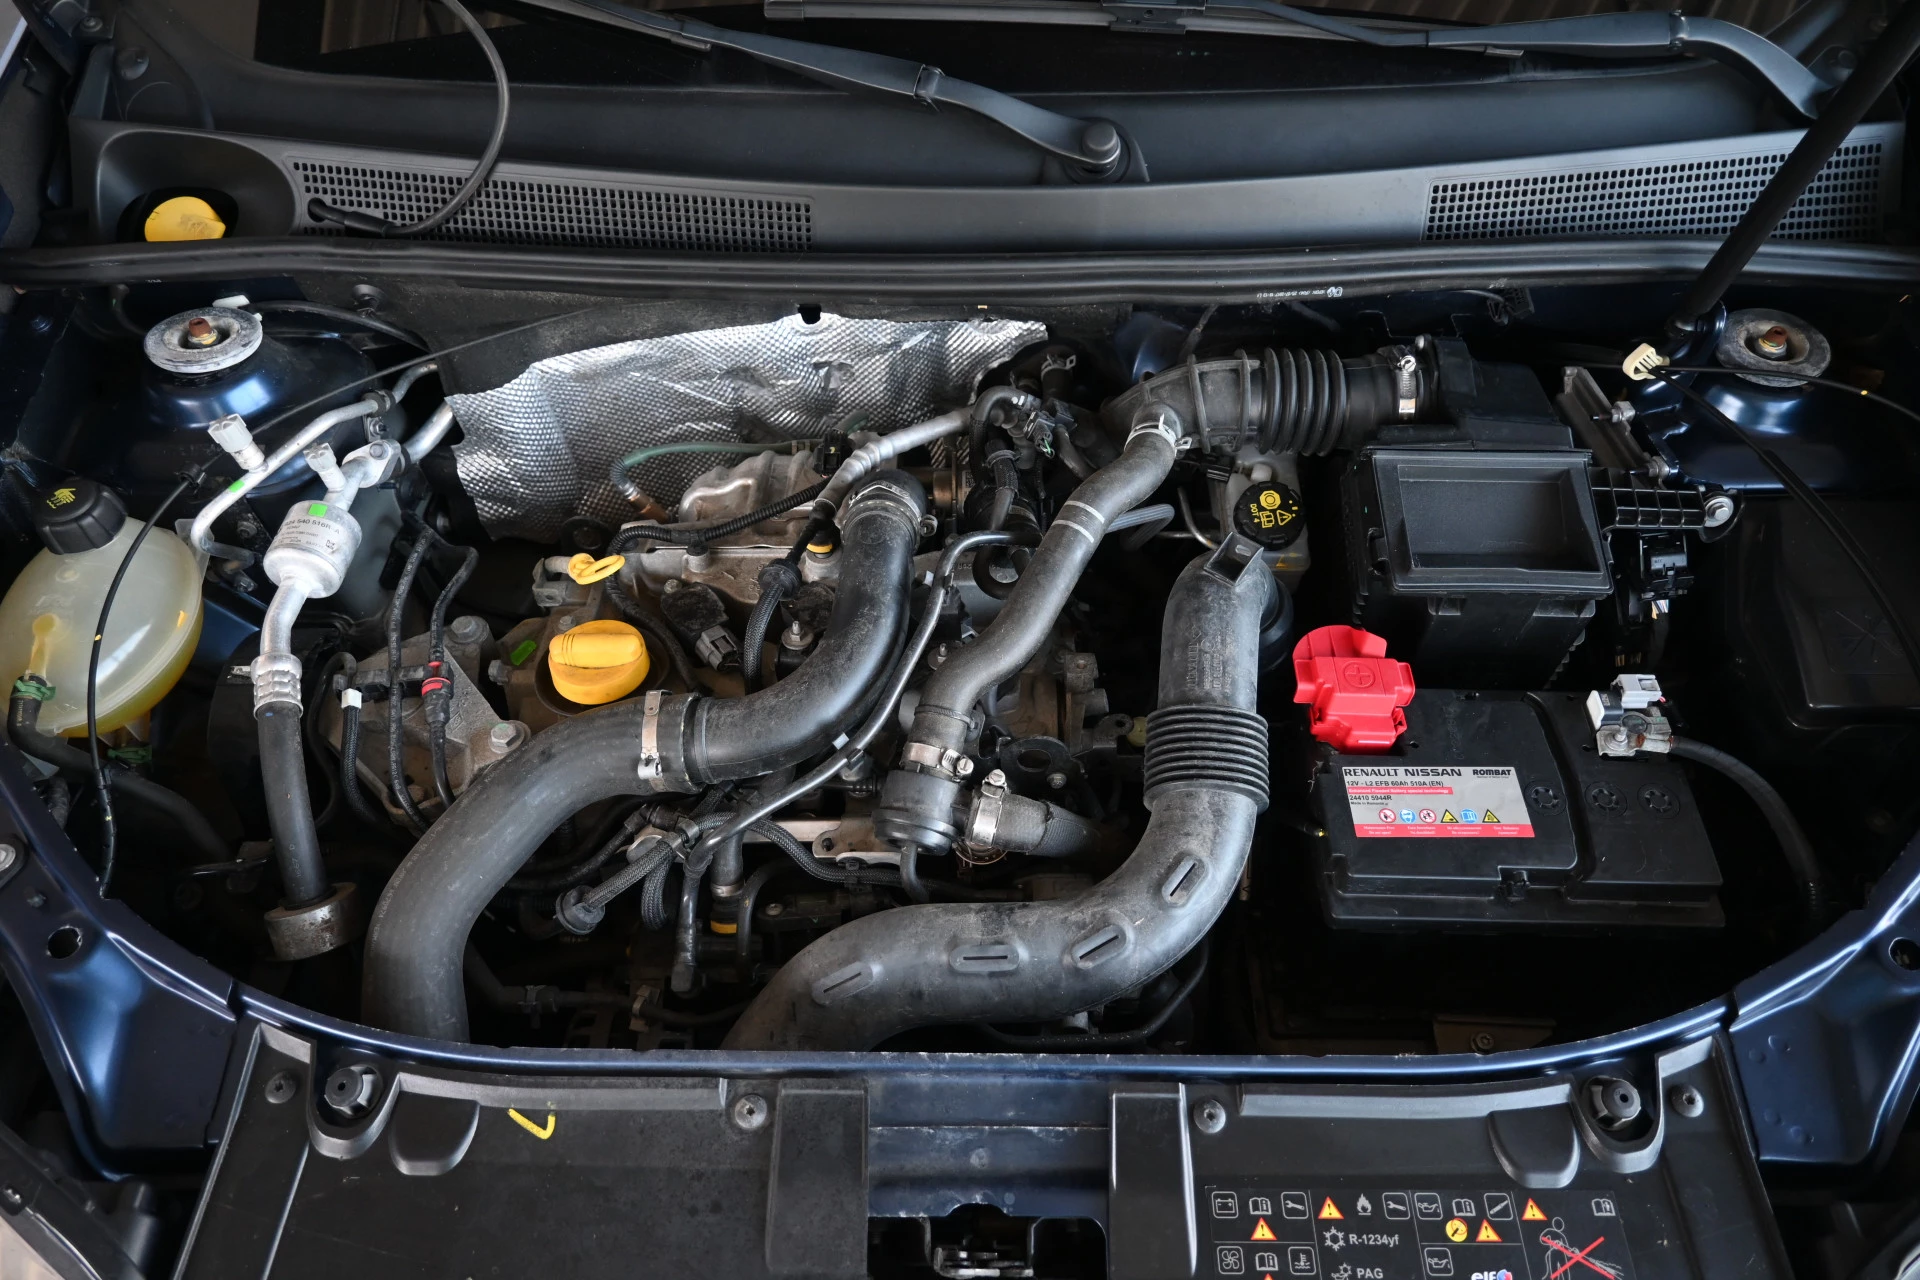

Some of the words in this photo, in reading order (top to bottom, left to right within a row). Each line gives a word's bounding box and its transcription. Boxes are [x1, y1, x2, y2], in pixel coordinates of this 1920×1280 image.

[1250, 503, 1260, 517] DOT
[1343, 768, 1399, 777] RENAULT
[1404, 768, 1462, 777] NISSAN
[1428, 780, 1444, 788] (EN)
[1348, 1233, 1400, 1247] R-1234yf
[1356, 1267, 1384, 1279] PAG
[1470, 1270, 1497, 1280] elf
